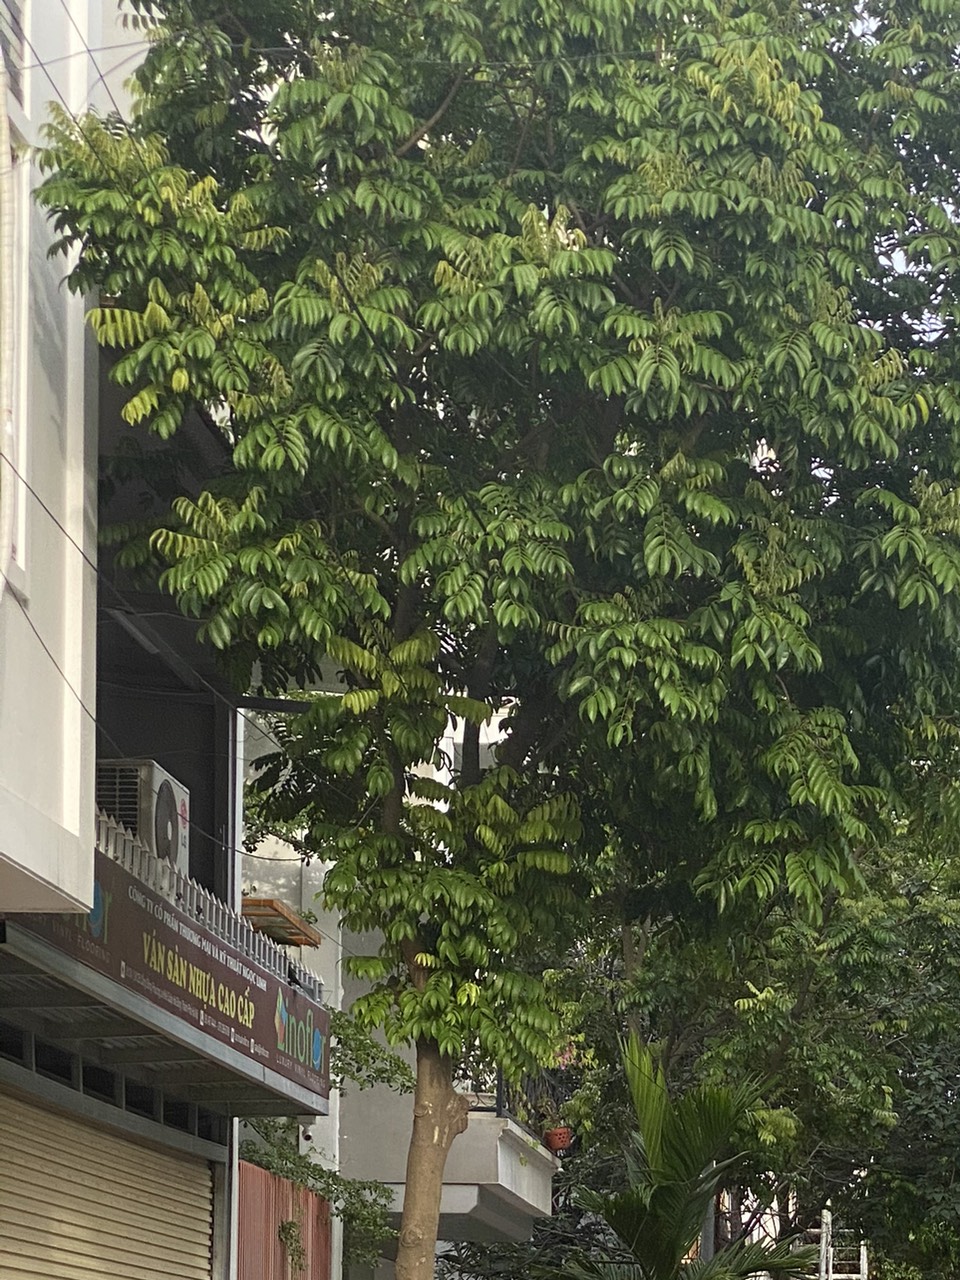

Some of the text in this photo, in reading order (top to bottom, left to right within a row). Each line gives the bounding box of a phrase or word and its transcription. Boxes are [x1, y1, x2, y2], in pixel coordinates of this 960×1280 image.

[128, 885, 146, 909] CÔNG
[167, 944, 187, 989] SÀN
[189, 963, 216, 1009] NHỰA
[218, 983, 236, 1019] CAO
[237, 986, 255, 1028] CẤP
